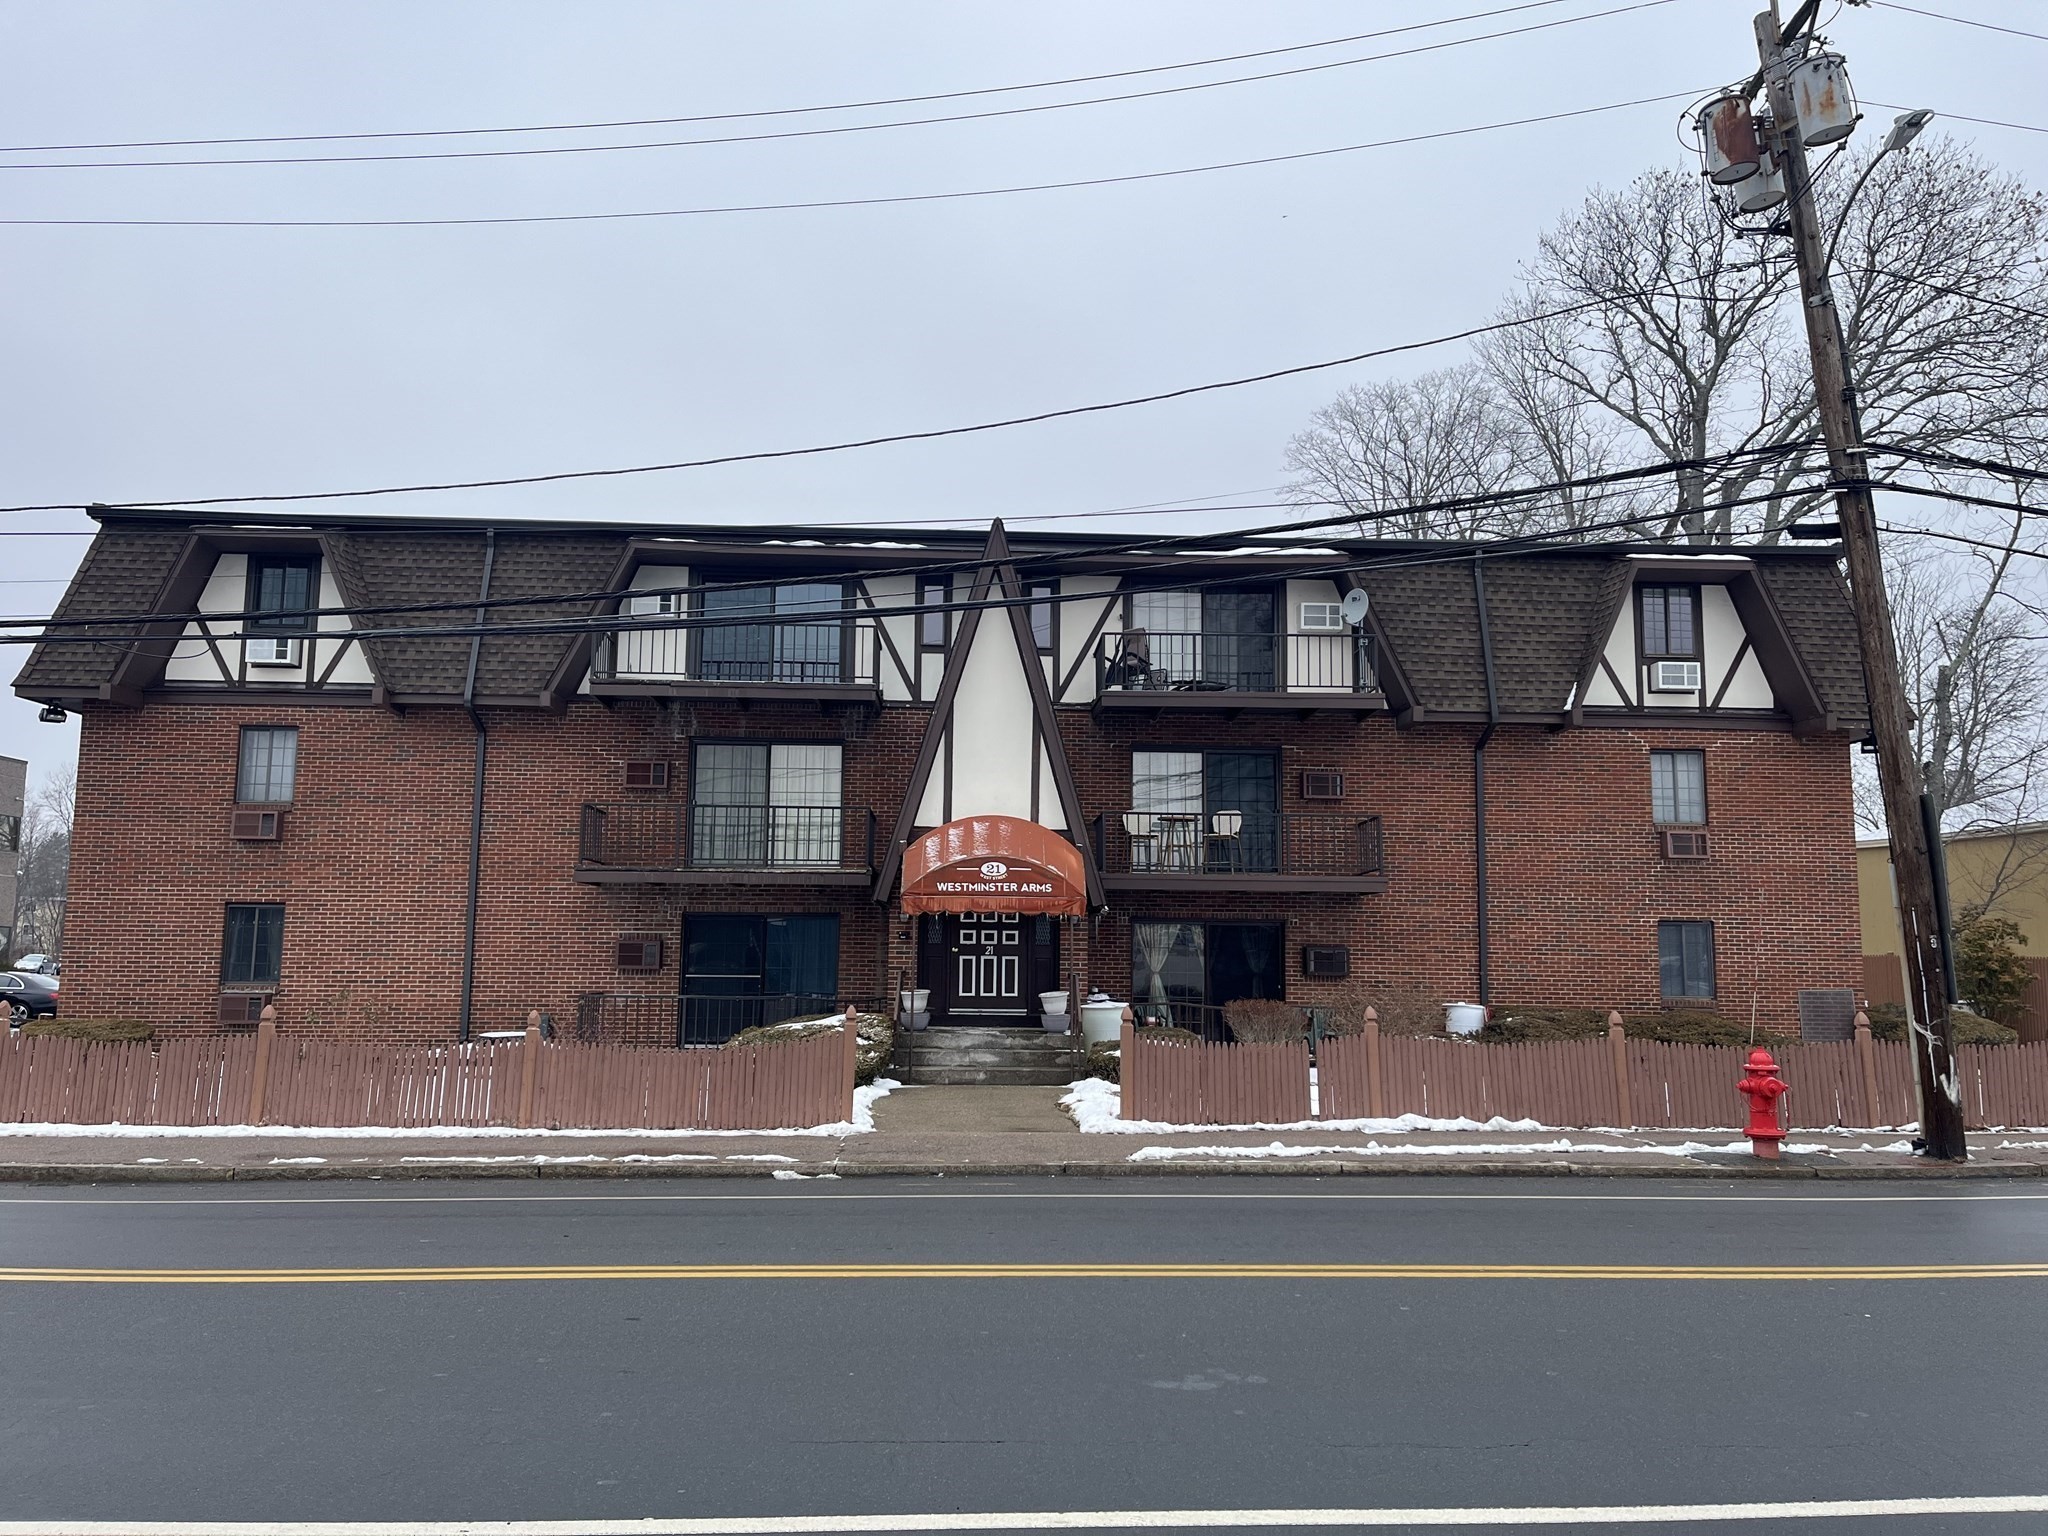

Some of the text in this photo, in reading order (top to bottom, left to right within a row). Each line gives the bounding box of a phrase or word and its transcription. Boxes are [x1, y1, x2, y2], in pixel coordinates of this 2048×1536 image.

[986, 863, 1001, 874] 21
[936, 883, 1052, 892] WESTMINSTER ARMS
[985, 945, 994, 955] 21
